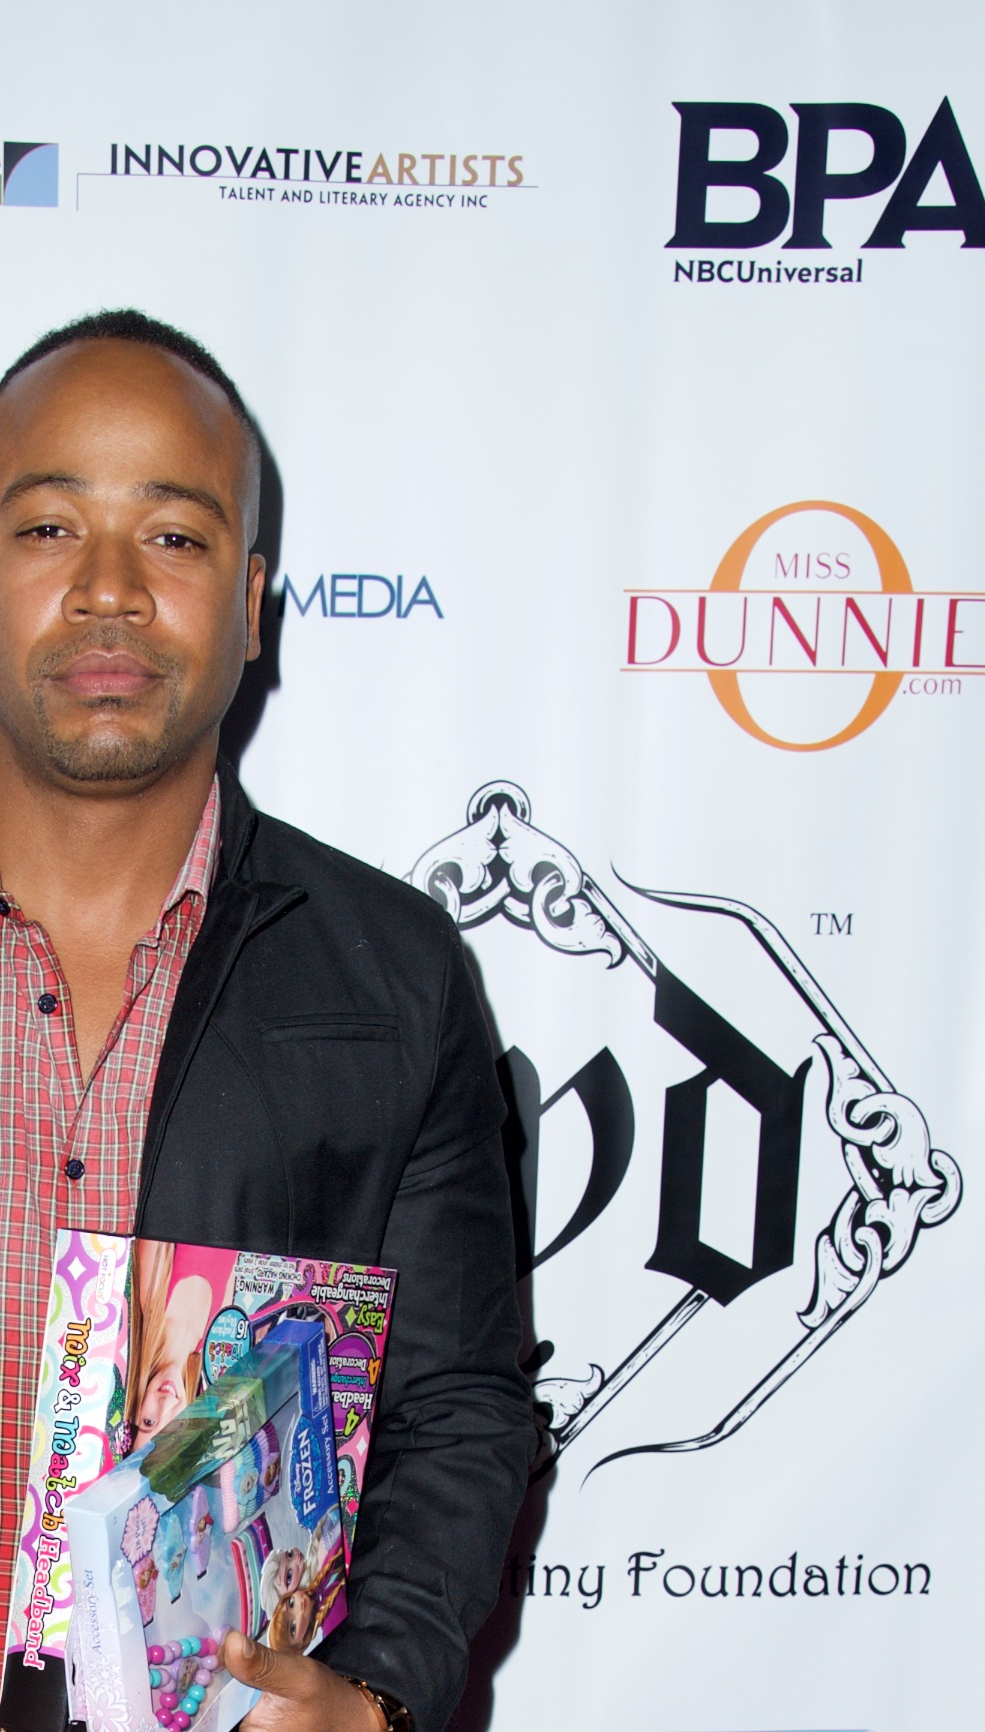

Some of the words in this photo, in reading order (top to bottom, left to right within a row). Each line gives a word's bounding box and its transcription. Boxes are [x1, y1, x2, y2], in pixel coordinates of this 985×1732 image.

[664, 95, 985, 250] BPA
[217, 185, 275, 204] TALENT
[280, 188, 314, 205] AND
[319, 189, 388, 207] LITERARY
[392, 193, 455, 209] AGENCY
[459, 194, 489, 209] INC
[673, 258, 863, 283] NBCUniversal
[774, 552, 851, 580] MISS
[278, 574, 444, 618] MEDIA
[626, 595, 985, 668] DUNNIE
[810, 913, 854, 936] TM
[343, 1272, 391, 1291] Decorations
[311, 1284, 389, 1309] Interchangeable
[236, 1319, 249, 1340] 16
[357, 1306, 386, 1334] Easy
[368, 1357, 381, 1385] 4
[332, 1391, 373, 1412] Headba
[344, 1407, 360, 1436] 4
[297, 1428, 316, 1516] FROZEN
[322, 1437, 334, 1494] Accessory
[85, 1569, 95, 1588] Set
[628, 1549, 931, 1598] Foundation
[23, 1536, 61, 1671] Headband
[88, 1589, 101, 1654] Accessory
